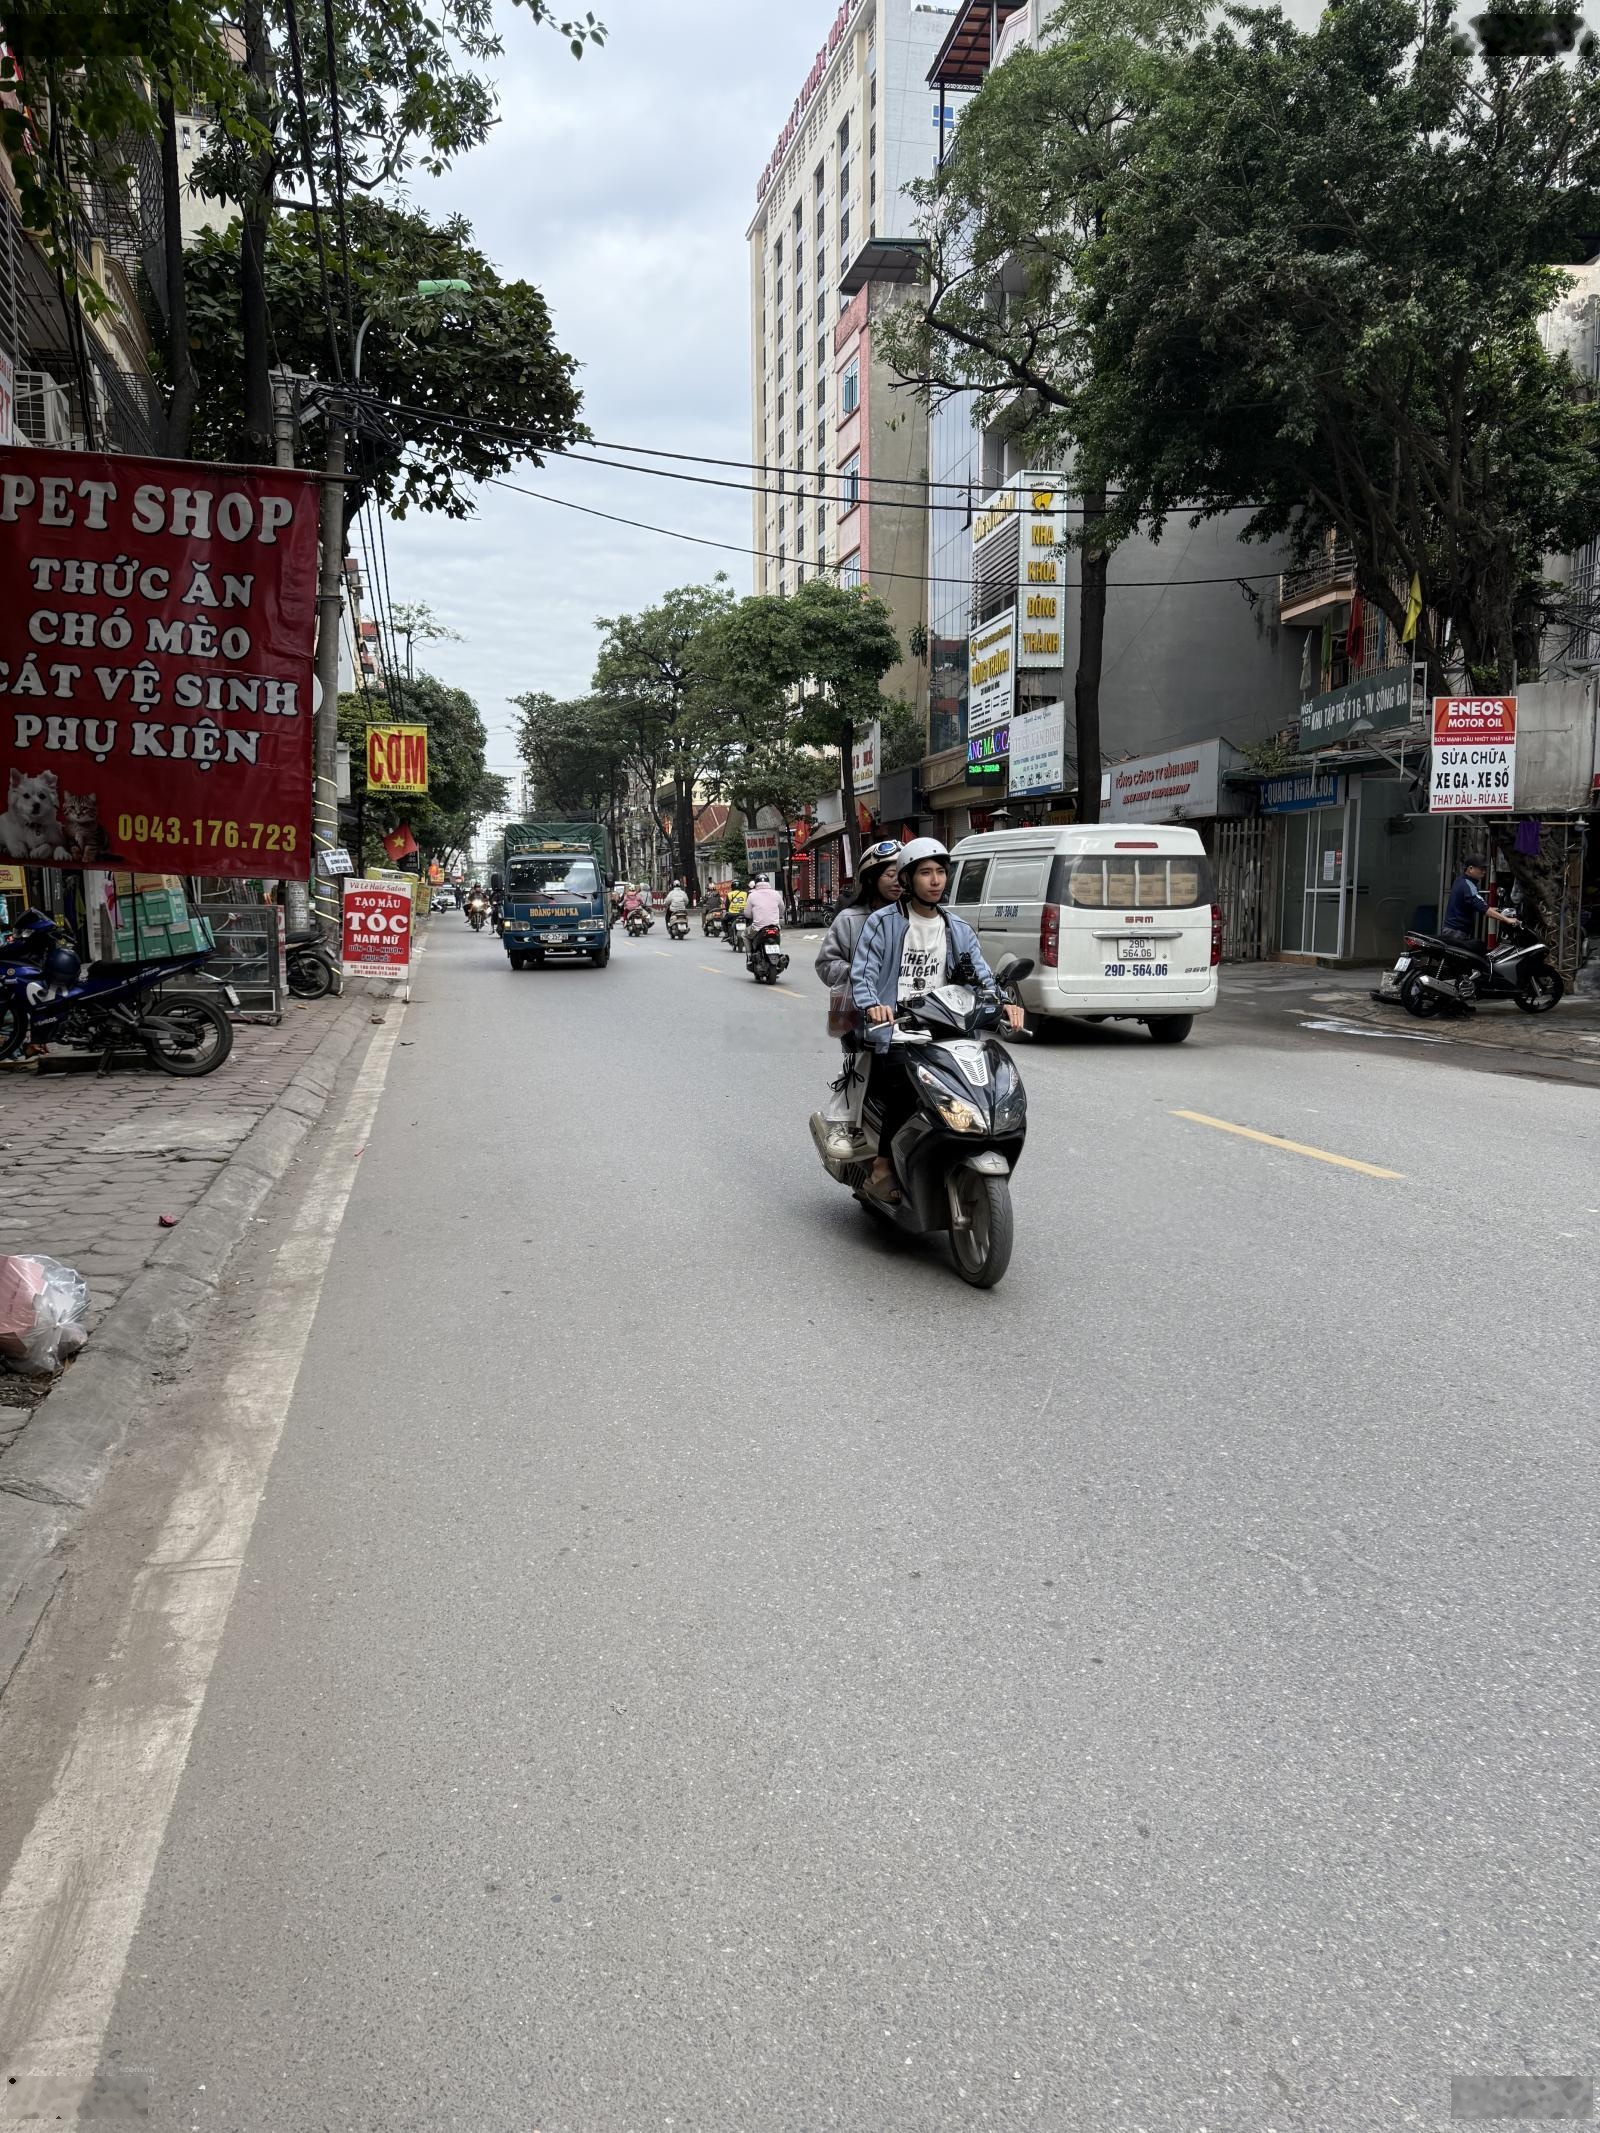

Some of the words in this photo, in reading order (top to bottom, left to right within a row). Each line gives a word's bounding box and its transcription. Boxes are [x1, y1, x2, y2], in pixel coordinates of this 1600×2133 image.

[0, 474, 117, 529] PET
[132, 484, 293, 543] SHOP
[1031, 525, 1054, 546] NHA
[29, 554, 170, 600] THỨC
[182, 560, 255, 608] ĂN
[1028, 561, 1056, 582] KHOA
[1026, 593, 1057, 618] ĐÔNG
[28, 607, 133, 649] CHÓ
[145, 614, 251, 660] MÈO
[1023, 628, 1059, 653] THÀNH
[94, 659, 161, 713] VỆ
[174, 673, 299, 715] SINH
[1311, 710, 1323, 731] KHU
[1347, 697, 1361, 720] 116
[1376, 685, 1395, 713] SÔNG
[1448, 701, 1504, 716] ENEOS
[1448, 718, 1485, 728] MOTOR
[1487, 718, 1503, 727] OIL
[14, 714, 118, 762] PHỤ
[131, 717, 260, 770] KIỆN
[369, 730, 425, 785] CƠM
[1441, 747, 1468, 765] SỬA
[1471, 747, 1507, 765] CHỮA
[1155, 767, 1164, 780] TY
[1436, 772, 1451, 789] XE
[1453, 772, 1469, 788] GA
[1477, 771, 1492, 788] XE
[1494, 765, 1510, 788] SỐ
[1433, 794, 1453, 805] THAY
[1455, 790, 1473, 804] DẦU
[1478, 790, 1496, 804] RỬA
[1498, 792, 1508, 803] XE
[118, 813, 297, 852] 0943.176.723
[386, 884, 407, 892] Salon
[354, 897, 376, 909] TẠO
[377, 895, 401, 909] MẪU
[346, 908, 409, 934] TÓC
[1125, 915, 1154, 924] SRM
[353, 933, 380, 944] NAM
[382, 934, 400, 945] NỮ
[1129, 939, 1145, 949] 29D
[904, 953, 931, 965] THEY
[1122, 948, 1152, 958] 564.06
